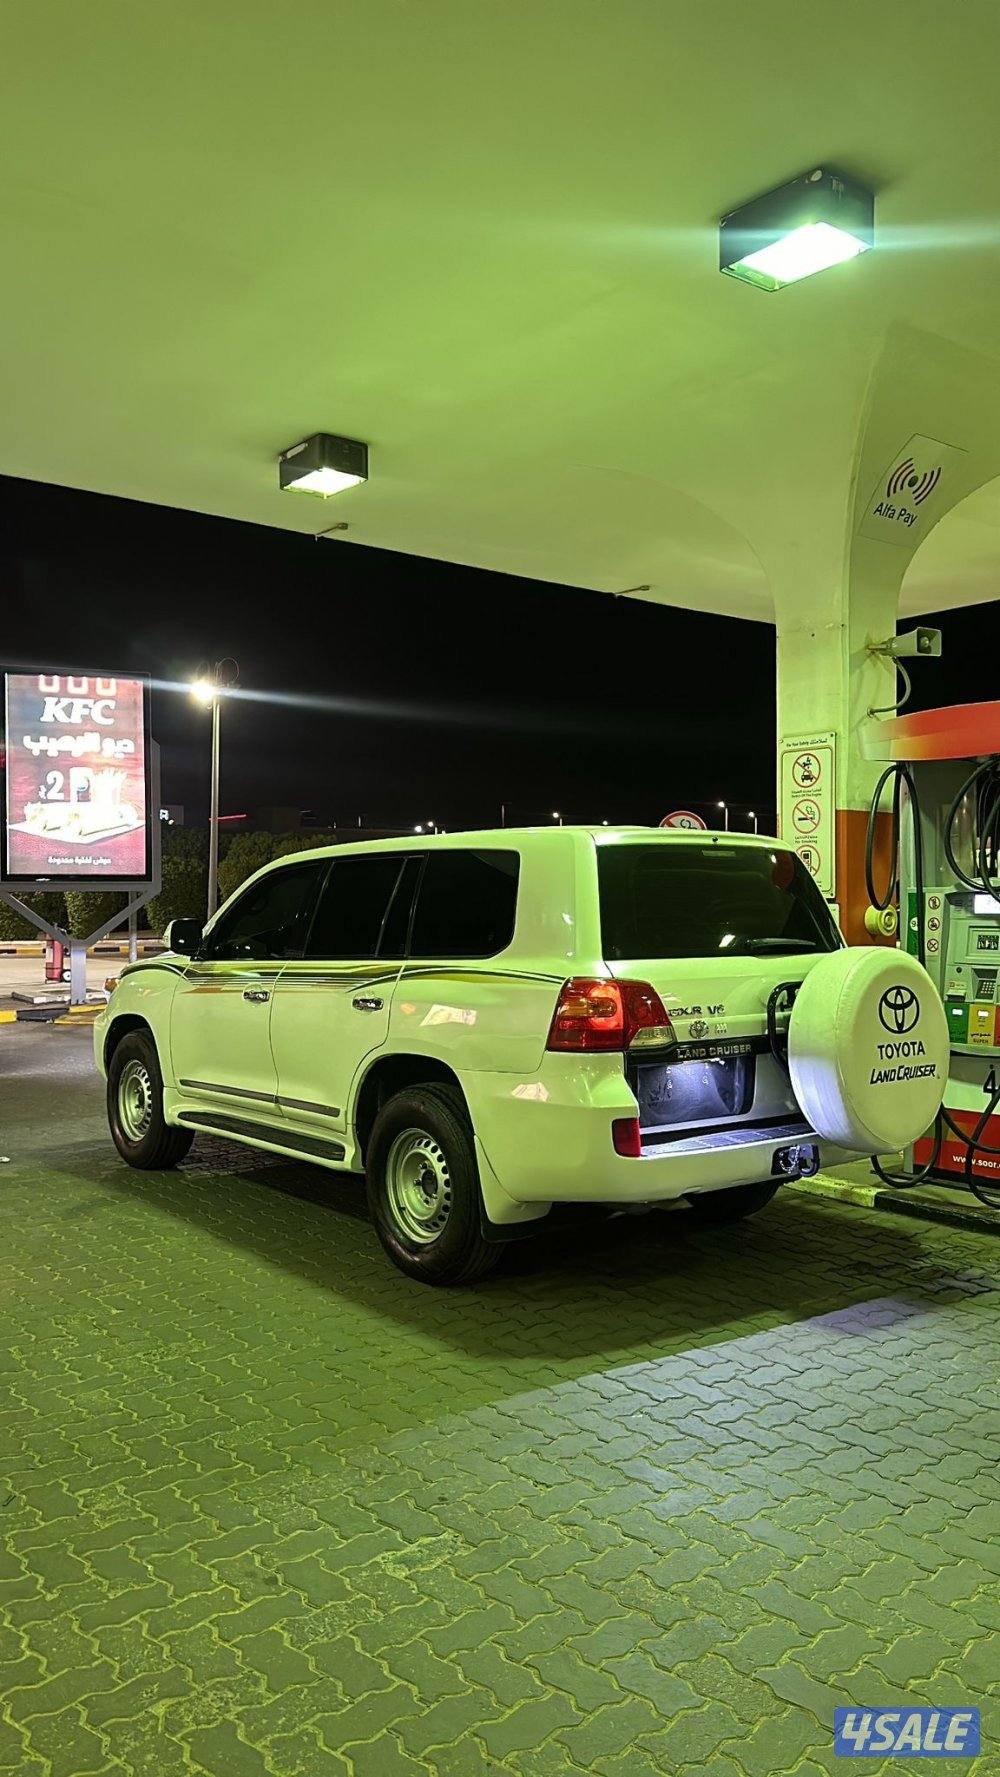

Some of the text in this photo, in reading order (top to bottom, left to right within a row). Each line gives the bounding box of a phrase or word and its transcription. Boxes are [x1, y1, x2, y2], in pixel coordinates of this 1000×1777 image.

[873, 502, 918, 527] Alfa Pay
[40, 697, 116, 725] KFC
[47, 771, 65, 800] 2
[676, 1044, 752, 1059] LAND CRUISER
[877, 1041, 926, 1060] TOYOTA
[870, 1064, 936, 1085] LAND CRUISER
[983, 1069, 997, 1094] 4
